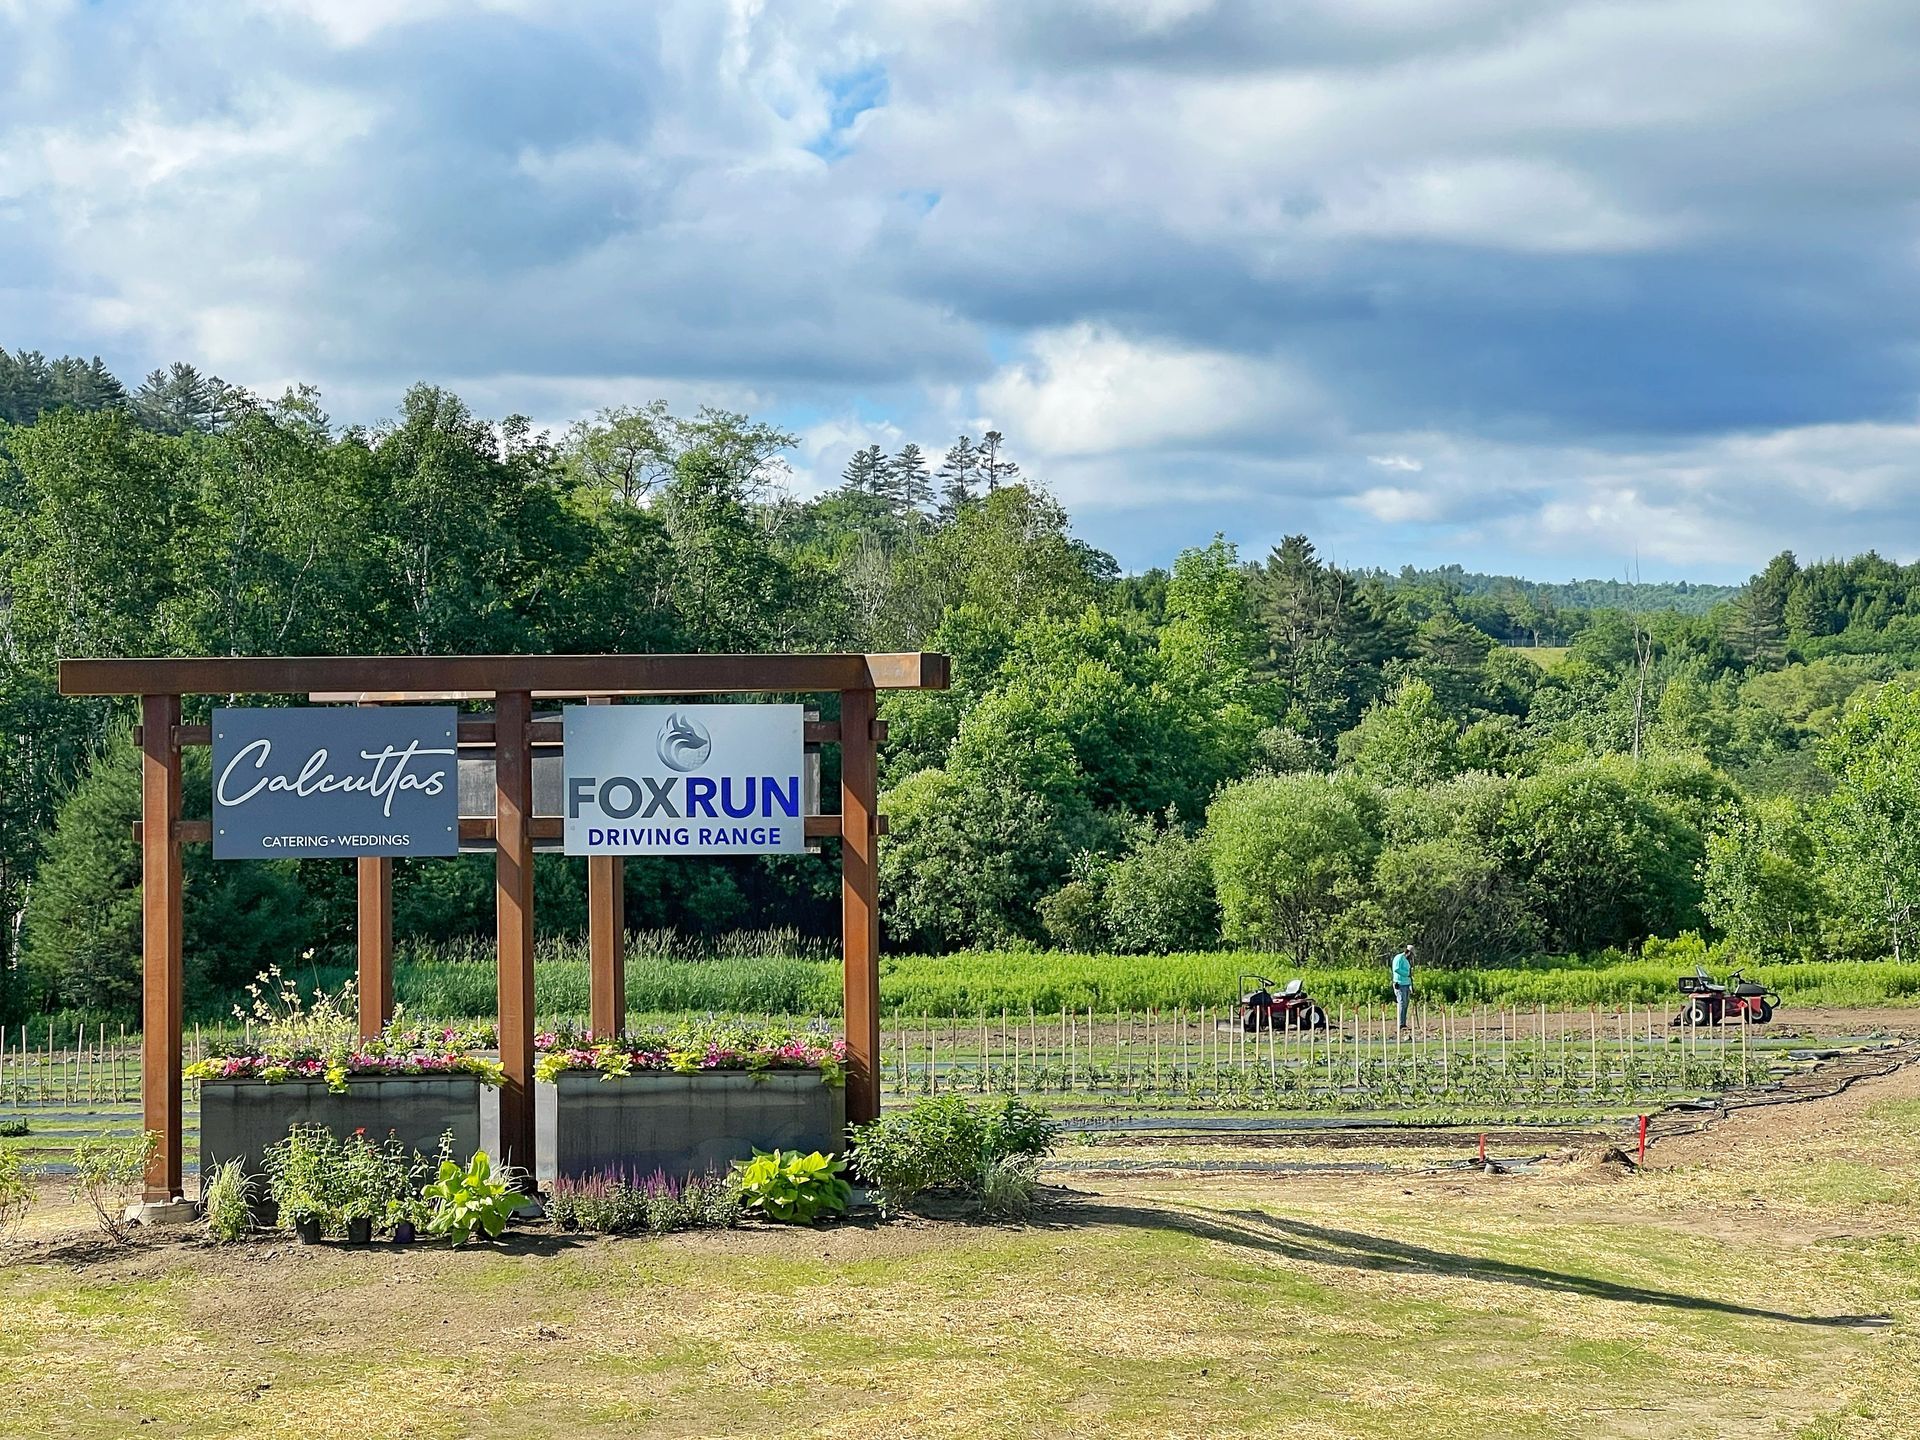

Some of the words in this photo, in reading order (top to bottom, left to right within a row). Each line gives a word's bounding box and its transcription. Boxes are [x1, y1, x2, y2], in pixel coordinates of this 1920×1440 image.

[217, 739, 456, 818] Calcuttas
[262, 835, 329, 848] CATERING
[337, 834, 410, 846] WEDDINGS
[588, 828, 690, 846] DRIVING
[699, 827, 781, 845] RANGE
